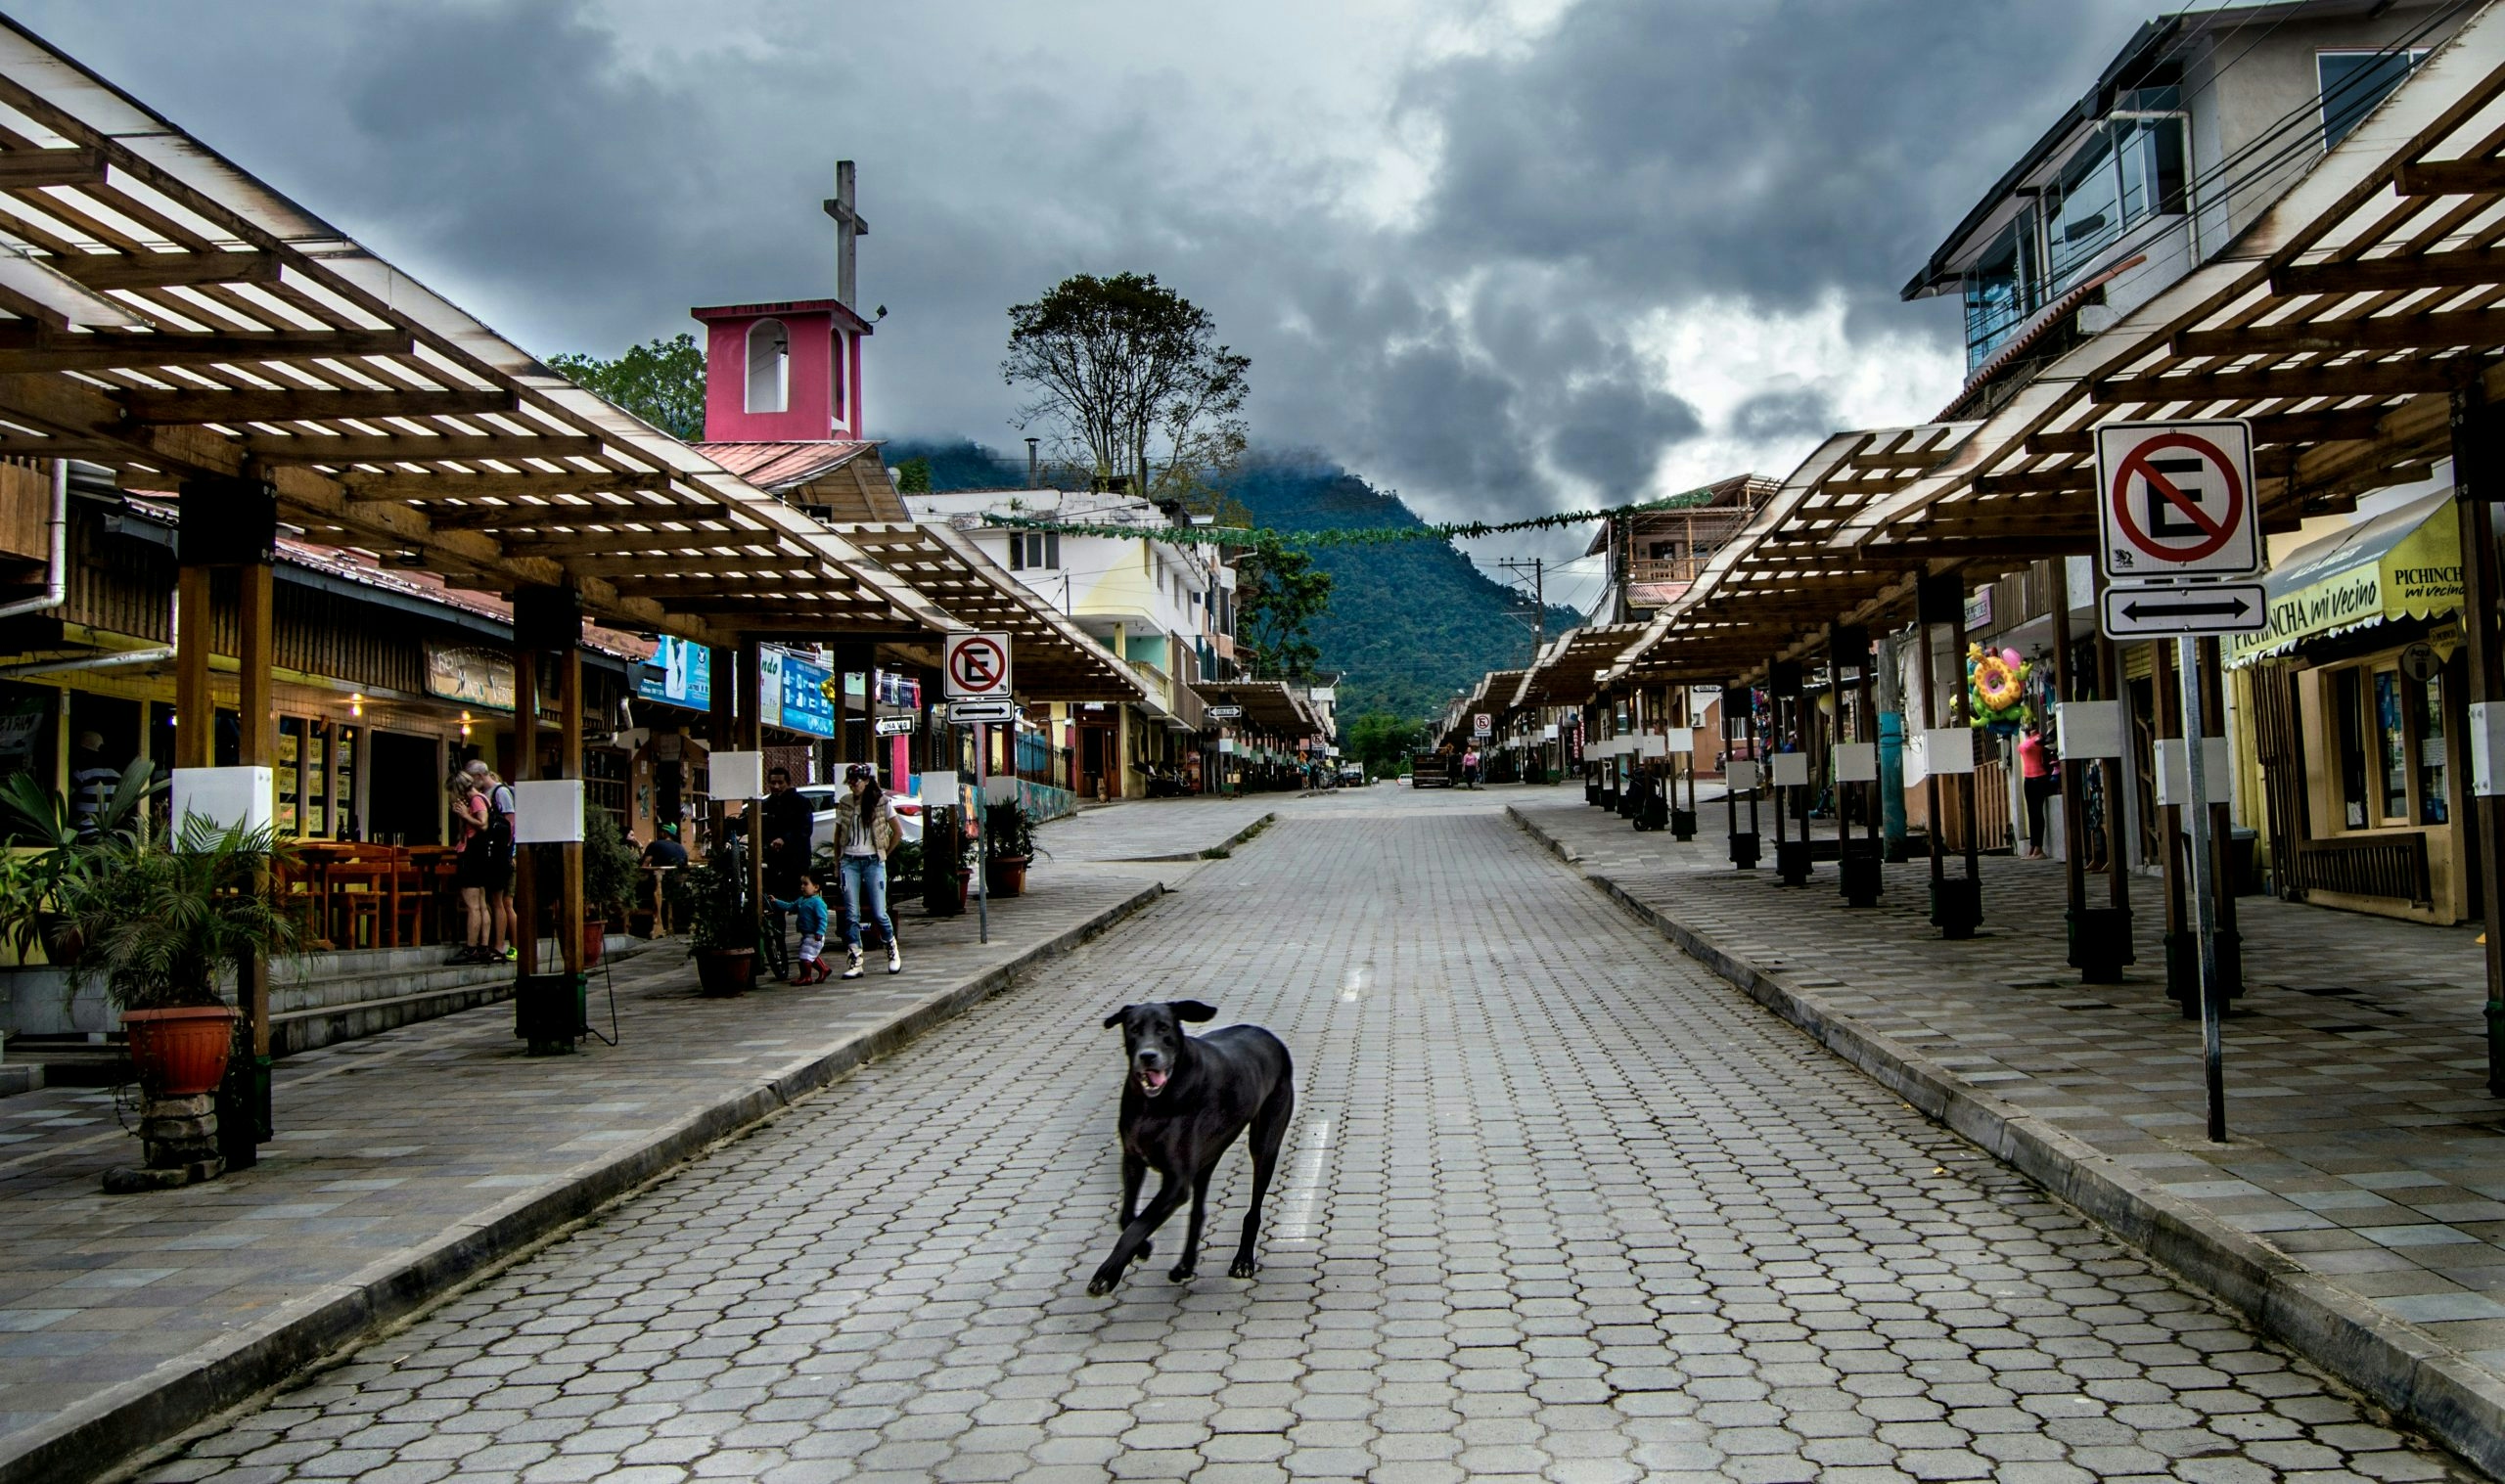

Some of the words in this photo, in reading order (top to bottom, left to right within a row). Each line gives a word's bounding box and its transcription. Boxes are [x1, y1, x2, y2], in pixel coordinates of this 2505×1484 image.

[2146, 458, 2211, 539] E
[2395, 566, 2464, 585] PICHINCH
[2405, 586, 2424, 599] mi
[2310, 588, 2329, 625] mi
[761, 656, 778, 675] ndo
[965, 649, 992, 682] E
